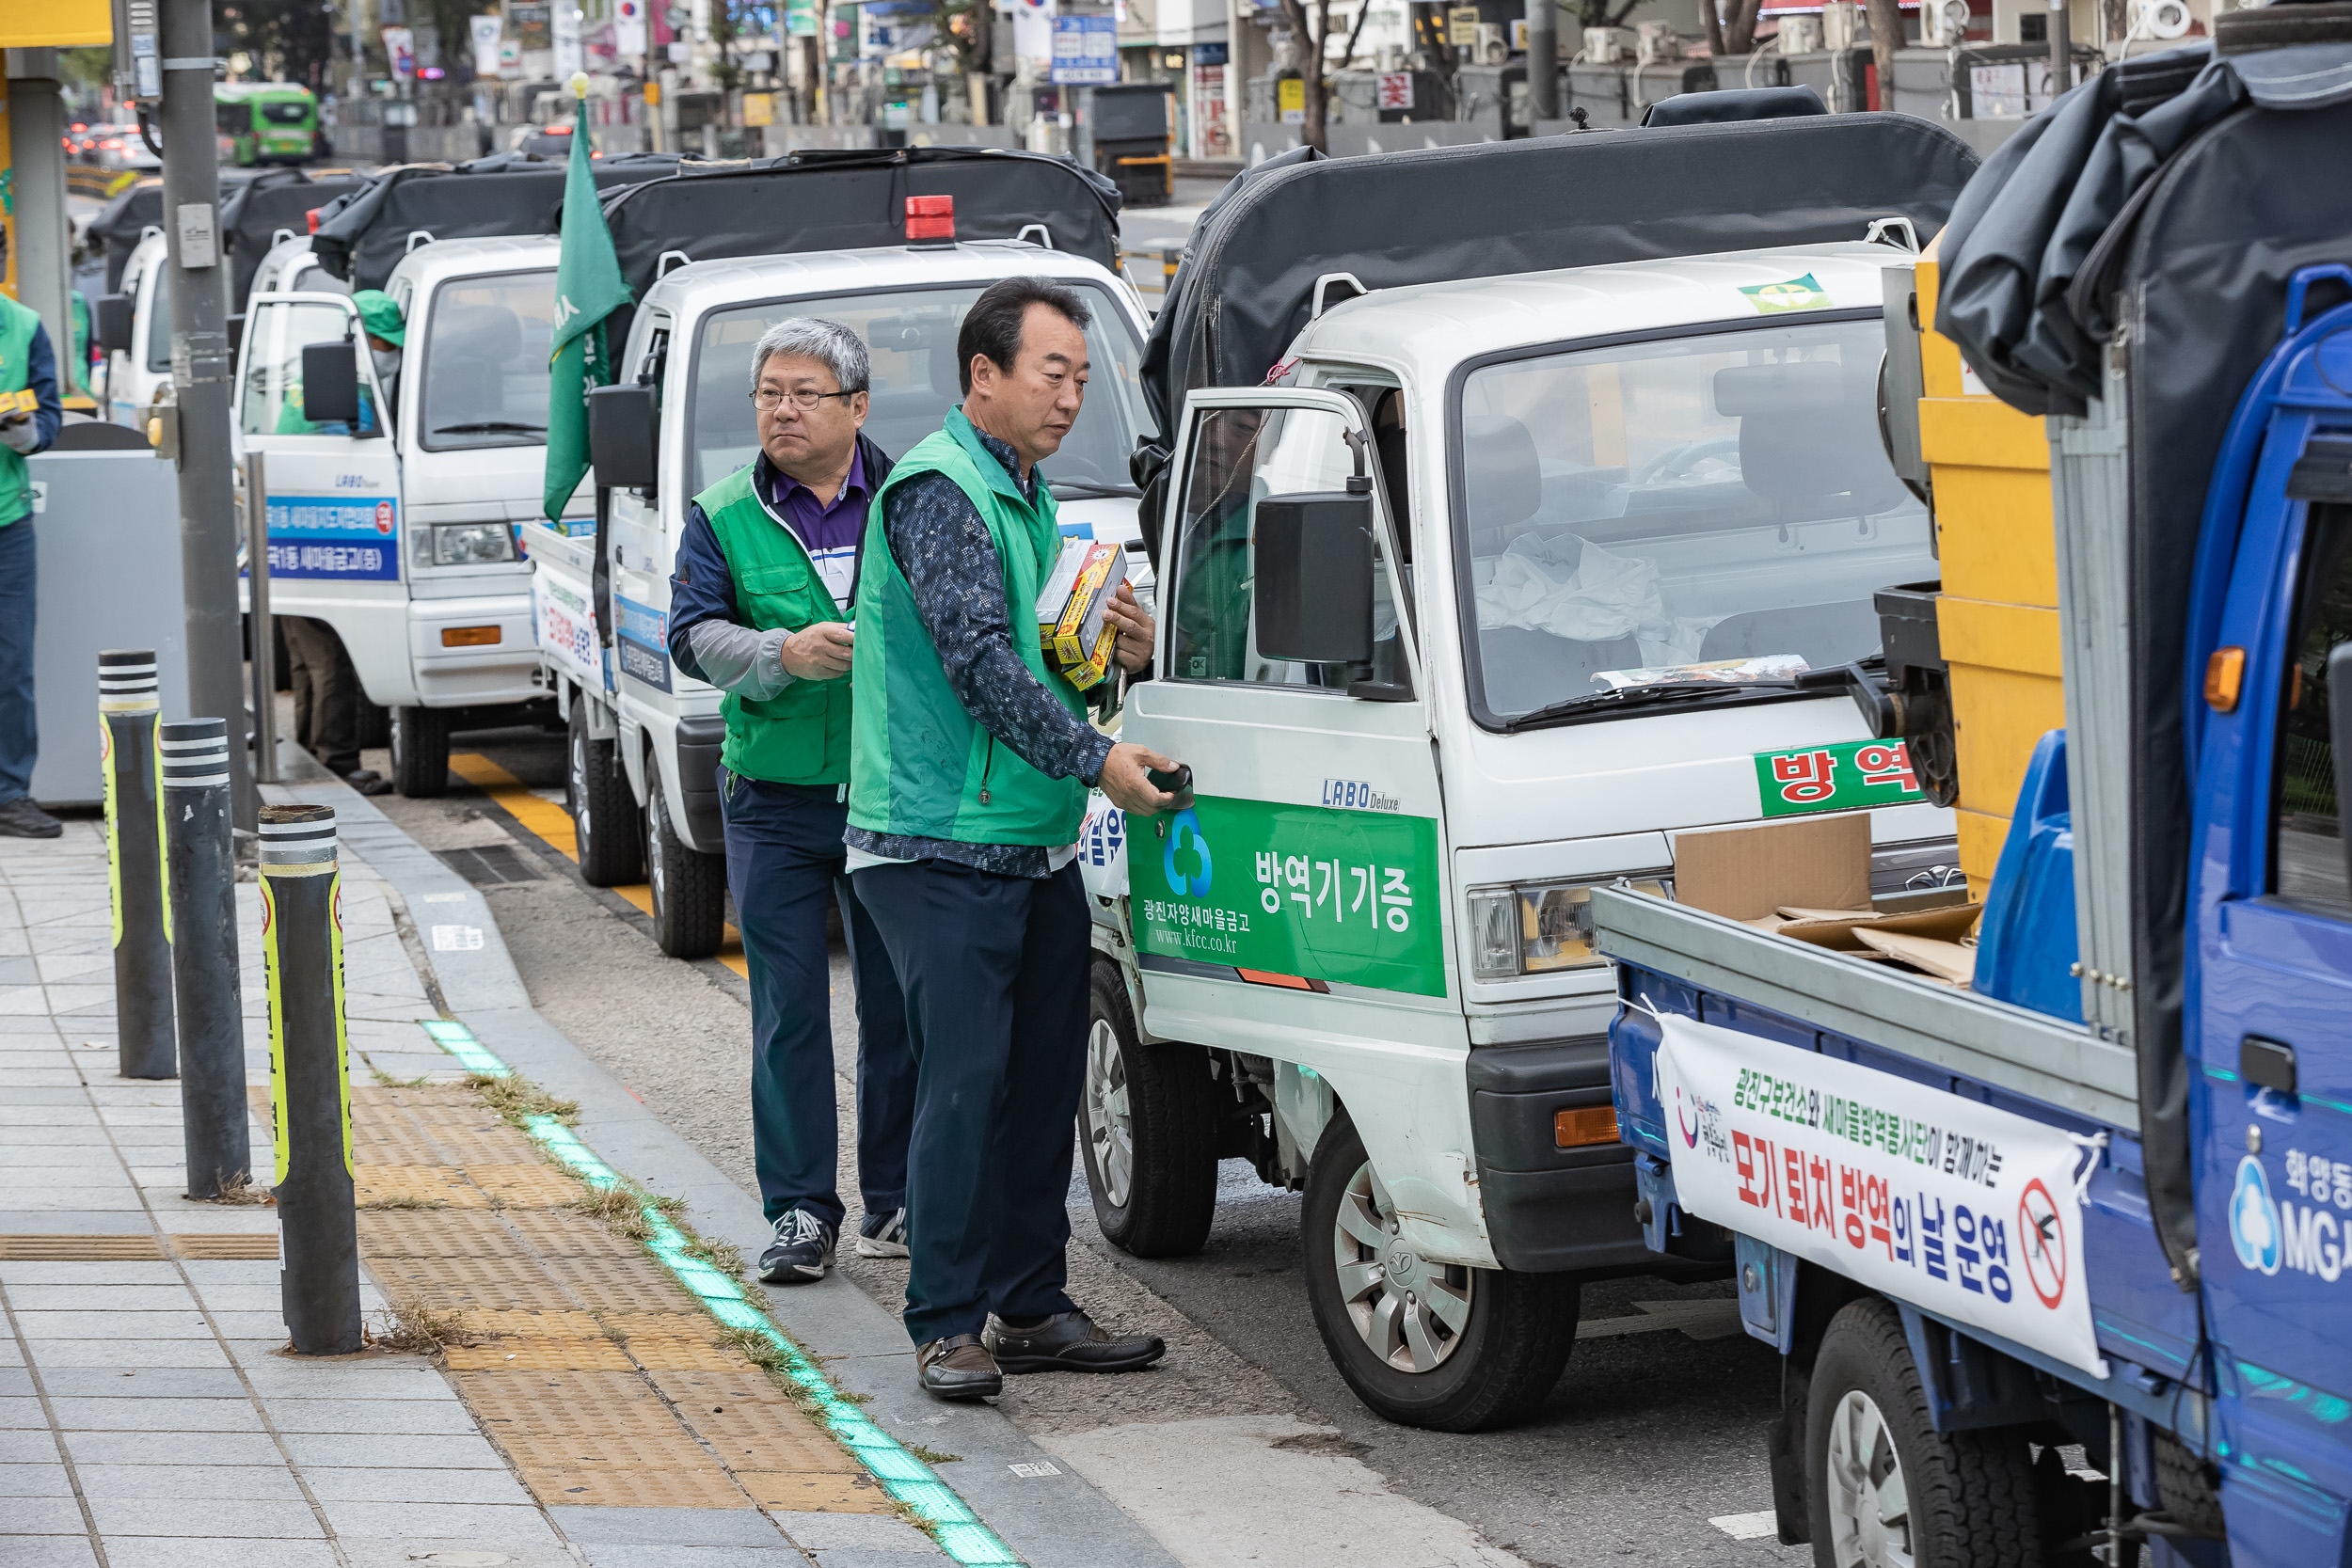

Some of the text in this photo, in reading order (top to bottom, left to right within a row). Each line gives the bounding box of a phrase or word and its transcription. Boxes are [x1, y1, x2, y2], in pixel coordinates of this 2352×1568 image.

[1322, 779, 1399, 812] LABO Deluxe
[1143, 898, 1251, 933] 광진자양새마을금고
[1255, 850, 1413, 933] 방역기 기증
[1155, 926, 1238, 954] www.kfcc.co.kr
[1734, 1068, 1820, 1131] 광진구보건소와
[1822, 1093, 1941, 1172] 새마을방역봉사단이
[1944, 1130, 2004, 1188] 함께하는
[2285, 1148, 2352, 1211] 화양동
[1731, 1129, 2012, 1304] 모기 퇴치 방역의 날 운영
